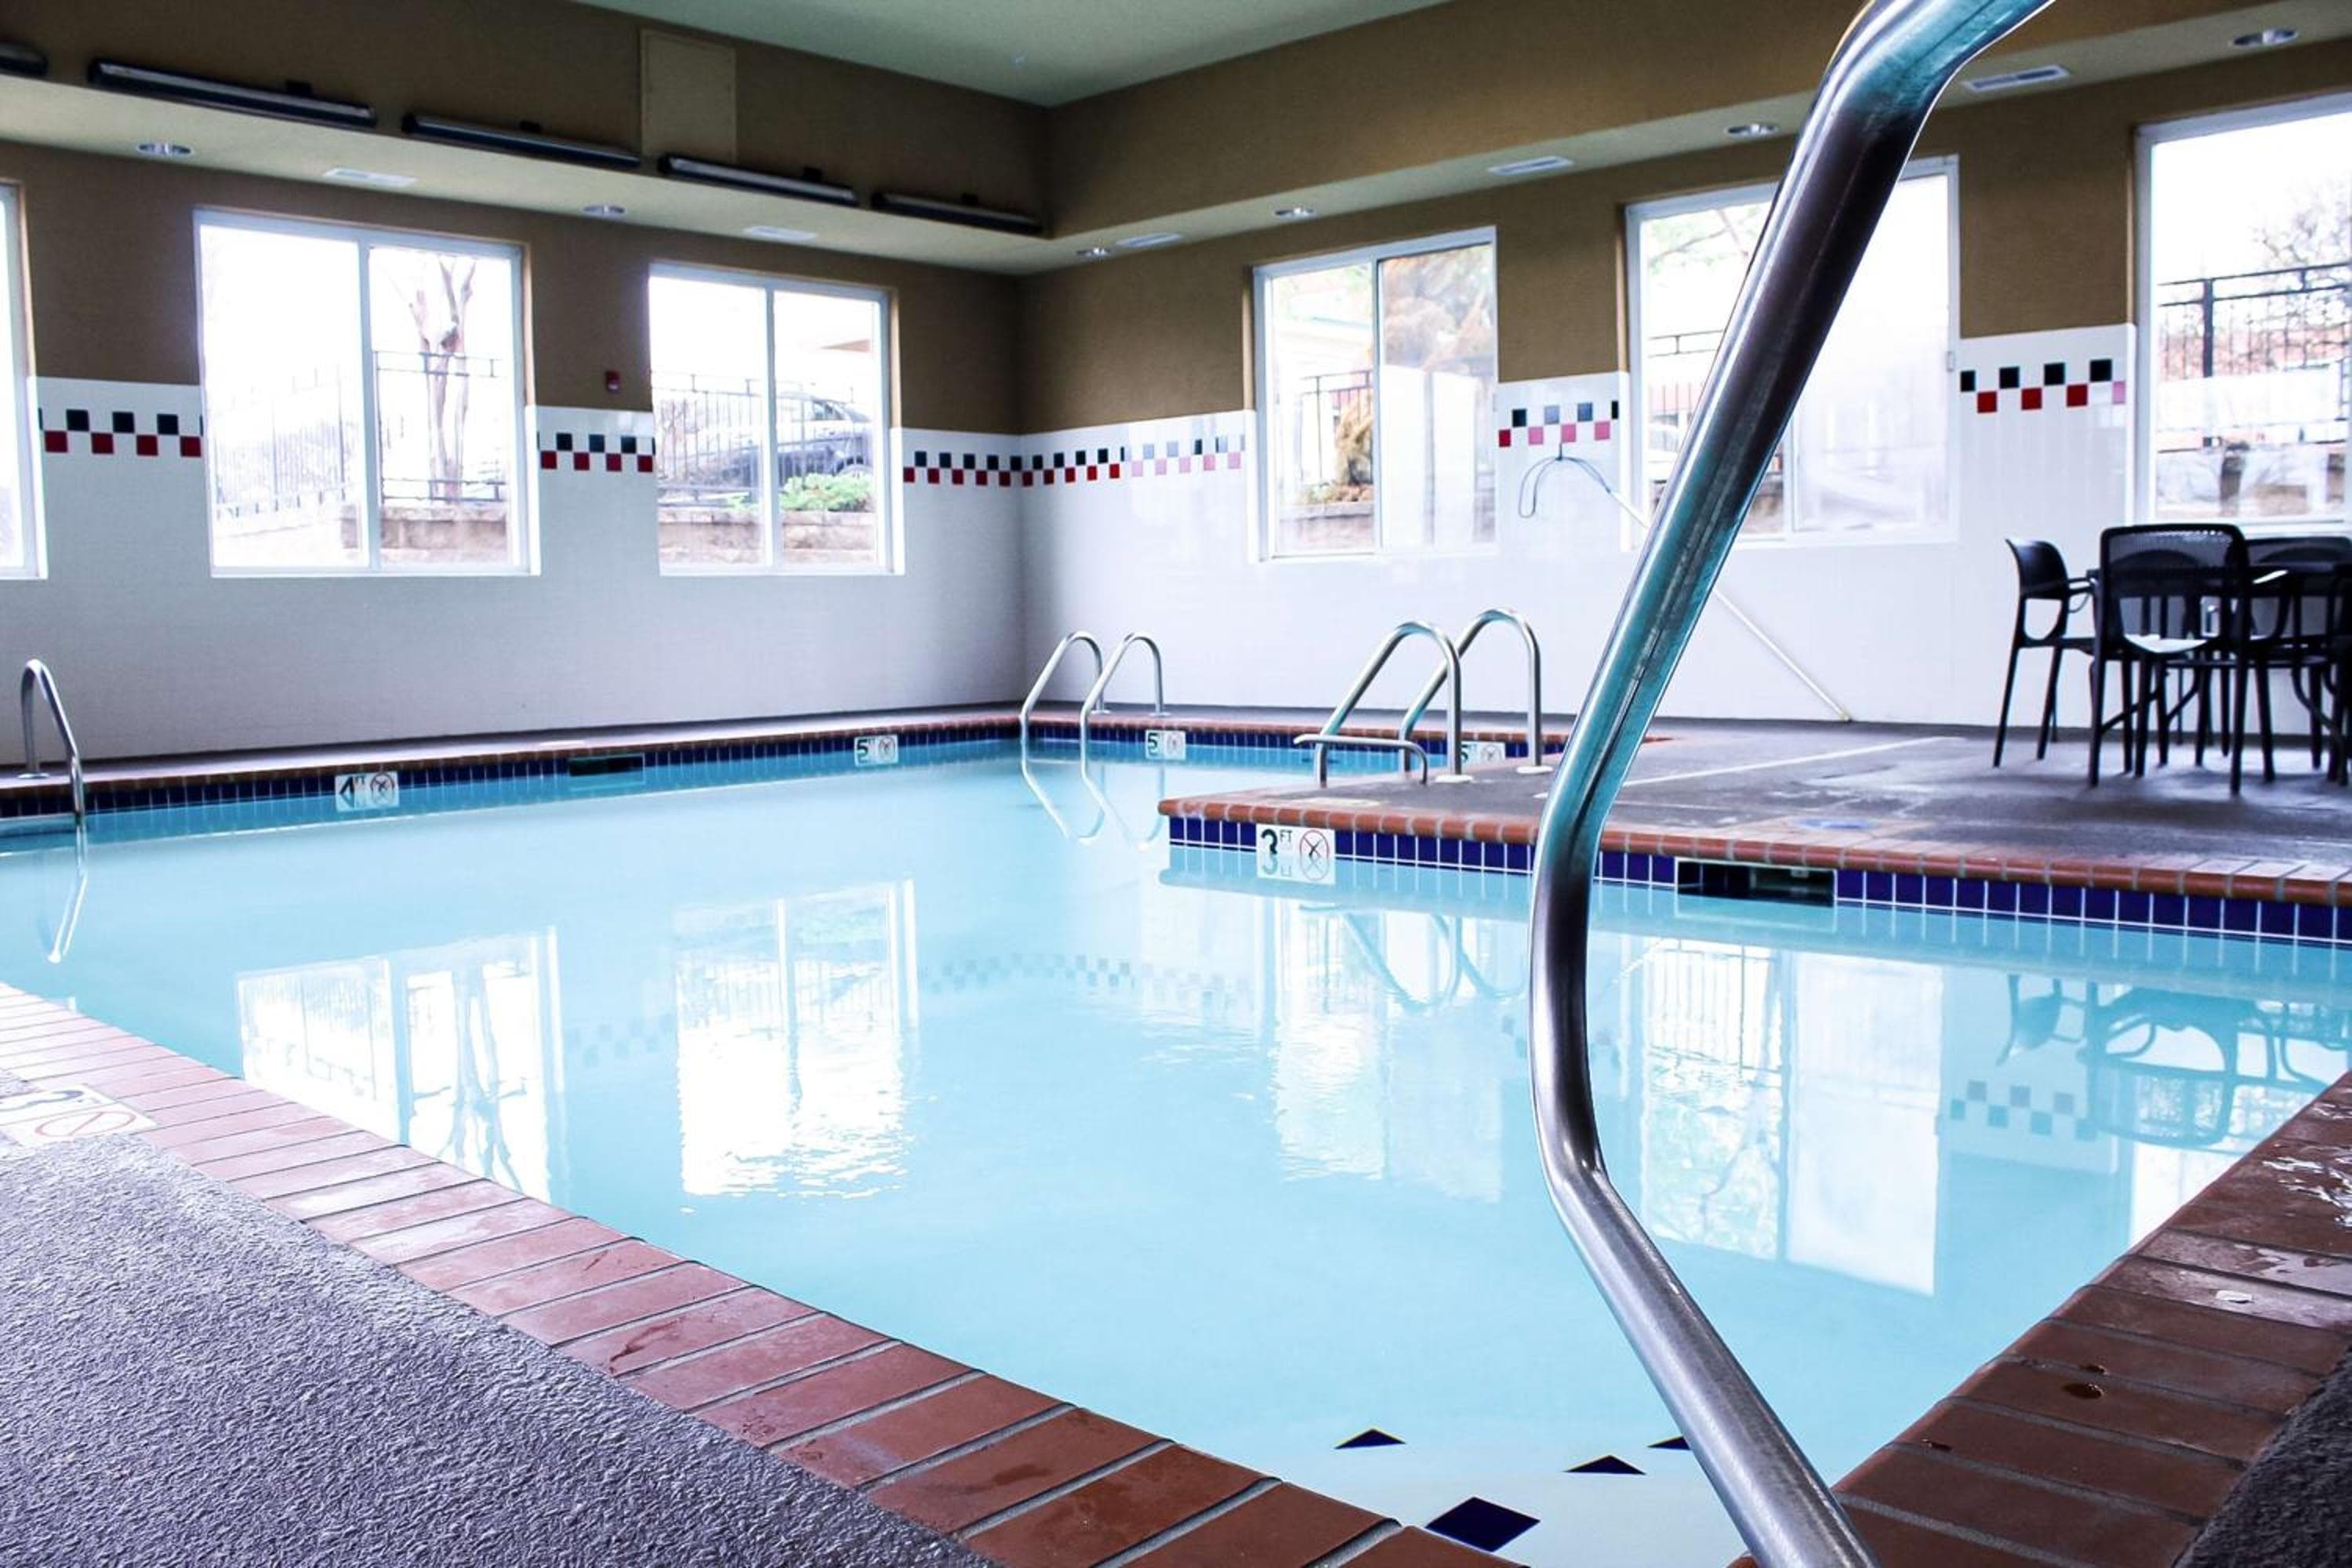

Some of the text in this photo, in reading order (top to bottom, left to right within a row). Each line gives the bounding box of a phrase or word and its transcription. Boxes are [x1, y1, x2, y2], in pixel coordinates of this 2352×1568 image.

[856, 739, 868, 756] 5
[1261, 829, 1292, 856] 3 FT
